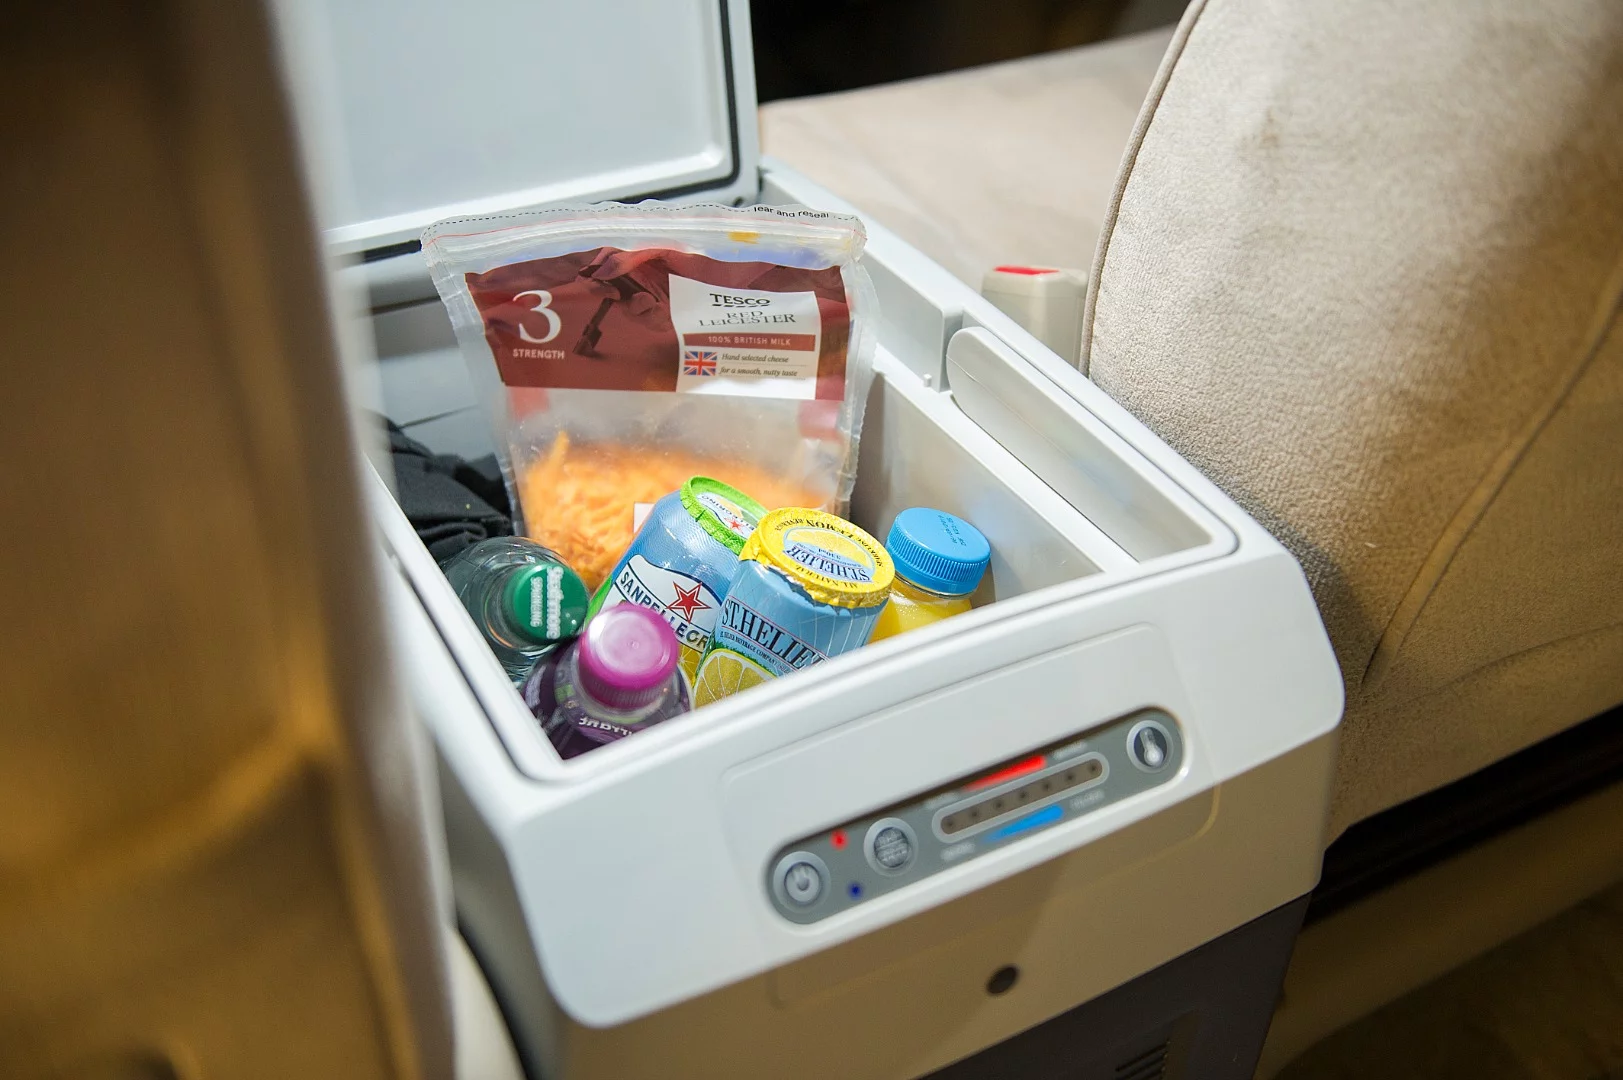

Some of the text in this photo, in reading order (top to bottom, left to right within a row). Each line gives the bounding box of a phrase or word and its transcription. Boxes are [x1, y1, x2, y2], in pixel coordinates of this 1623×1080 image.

[798, 210, 829, 219] reseal
[709, 293, 771, 306] TESCO
[512, 289, 562, 344] 3
[698, 313, 797, 327] LEICESTER
[726, 310, 764, 319] RED
[707, 335, 792, 346] 100% BRITISH MILK
[512, 347, 566, 359] STRENGTH
[721, 353, 789, 363] Hand selected cheese
[718, 366, 731, 375] for
[763, 369, 781, 378] nutty
[784, 545, 871, 582] ST.HELIER
